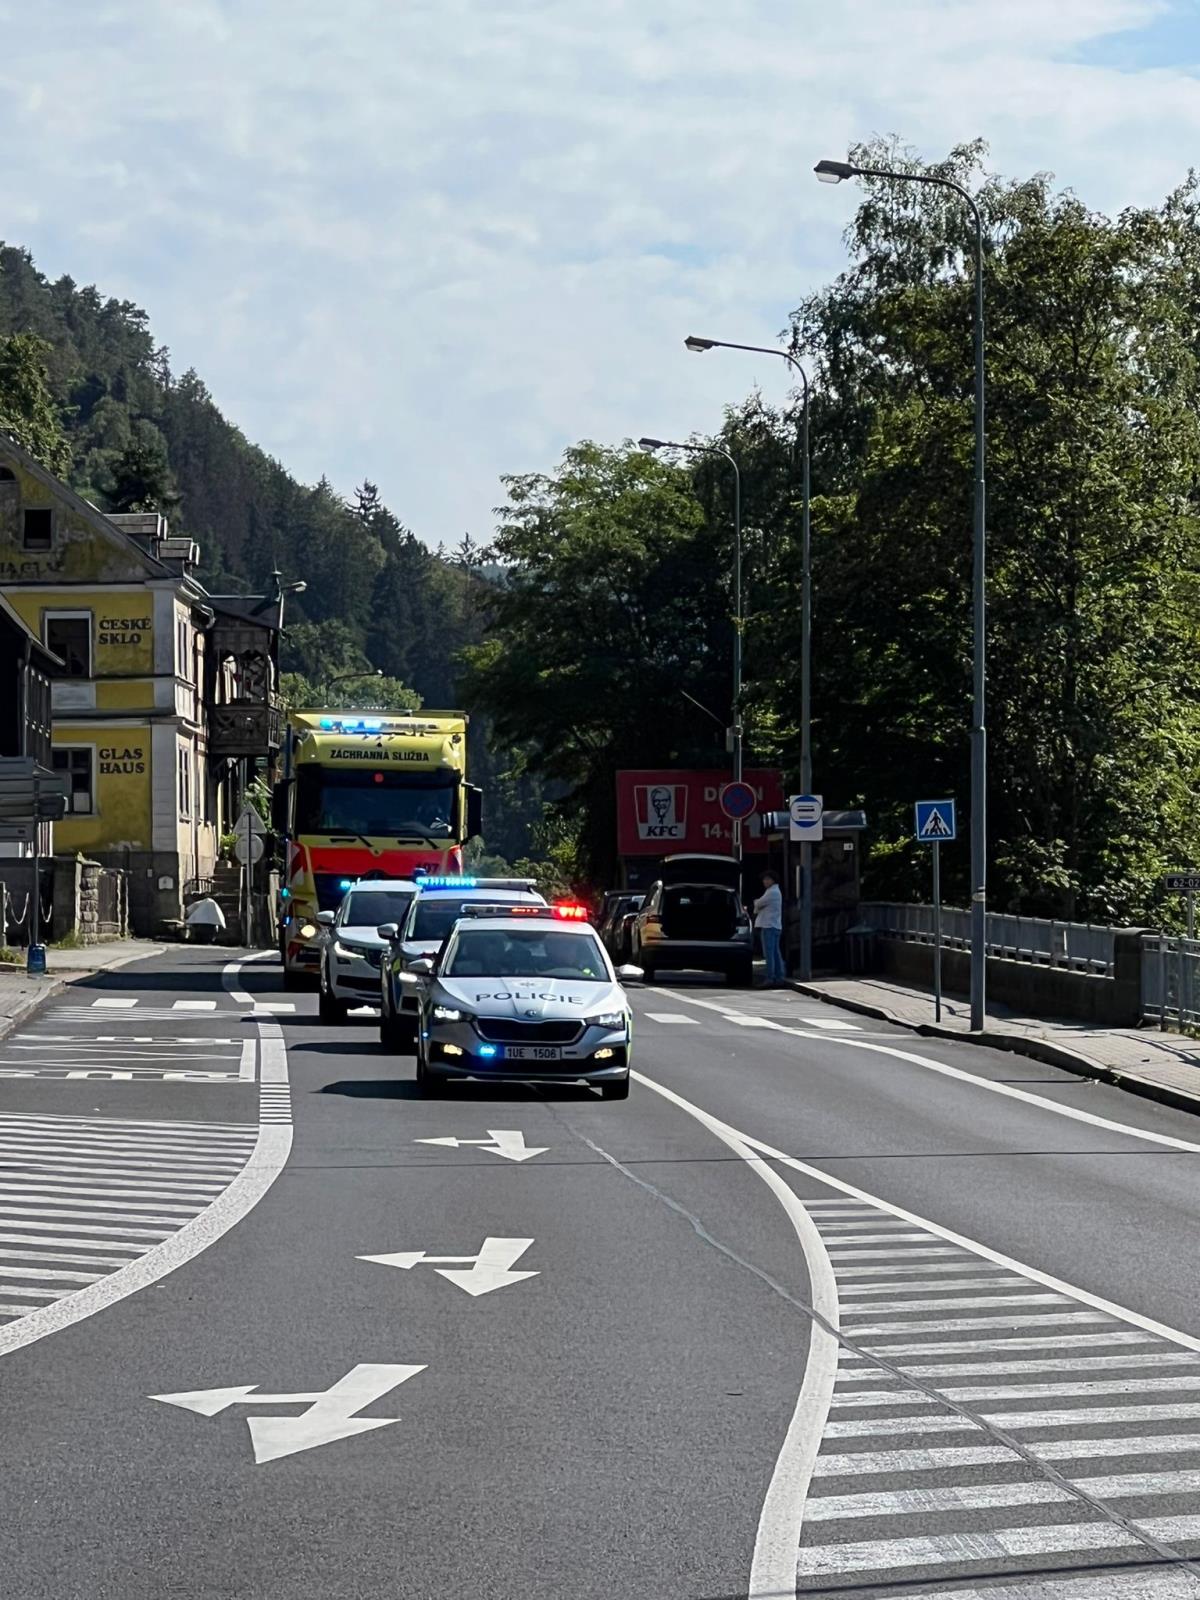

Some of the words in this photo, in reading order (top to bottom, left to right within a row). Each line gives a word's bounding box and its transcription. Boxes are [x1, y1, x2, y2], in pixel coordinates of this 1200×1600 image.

[98, 633, 142, 645] SKLO
[99, 748, 143, 760] GLAS
[330, 748, 390, 760] ZÁCHRANNÁ
[392, 749, 430, 761] SLUŽBA
[99, 762, 145, 774] HAUS
[646, 826, 678, 837] KFC
[701, 823, 722, 838] 14
[475, 992, 584, 1005] POLICIE
[507, 1047, 526, 1058] 1UE
